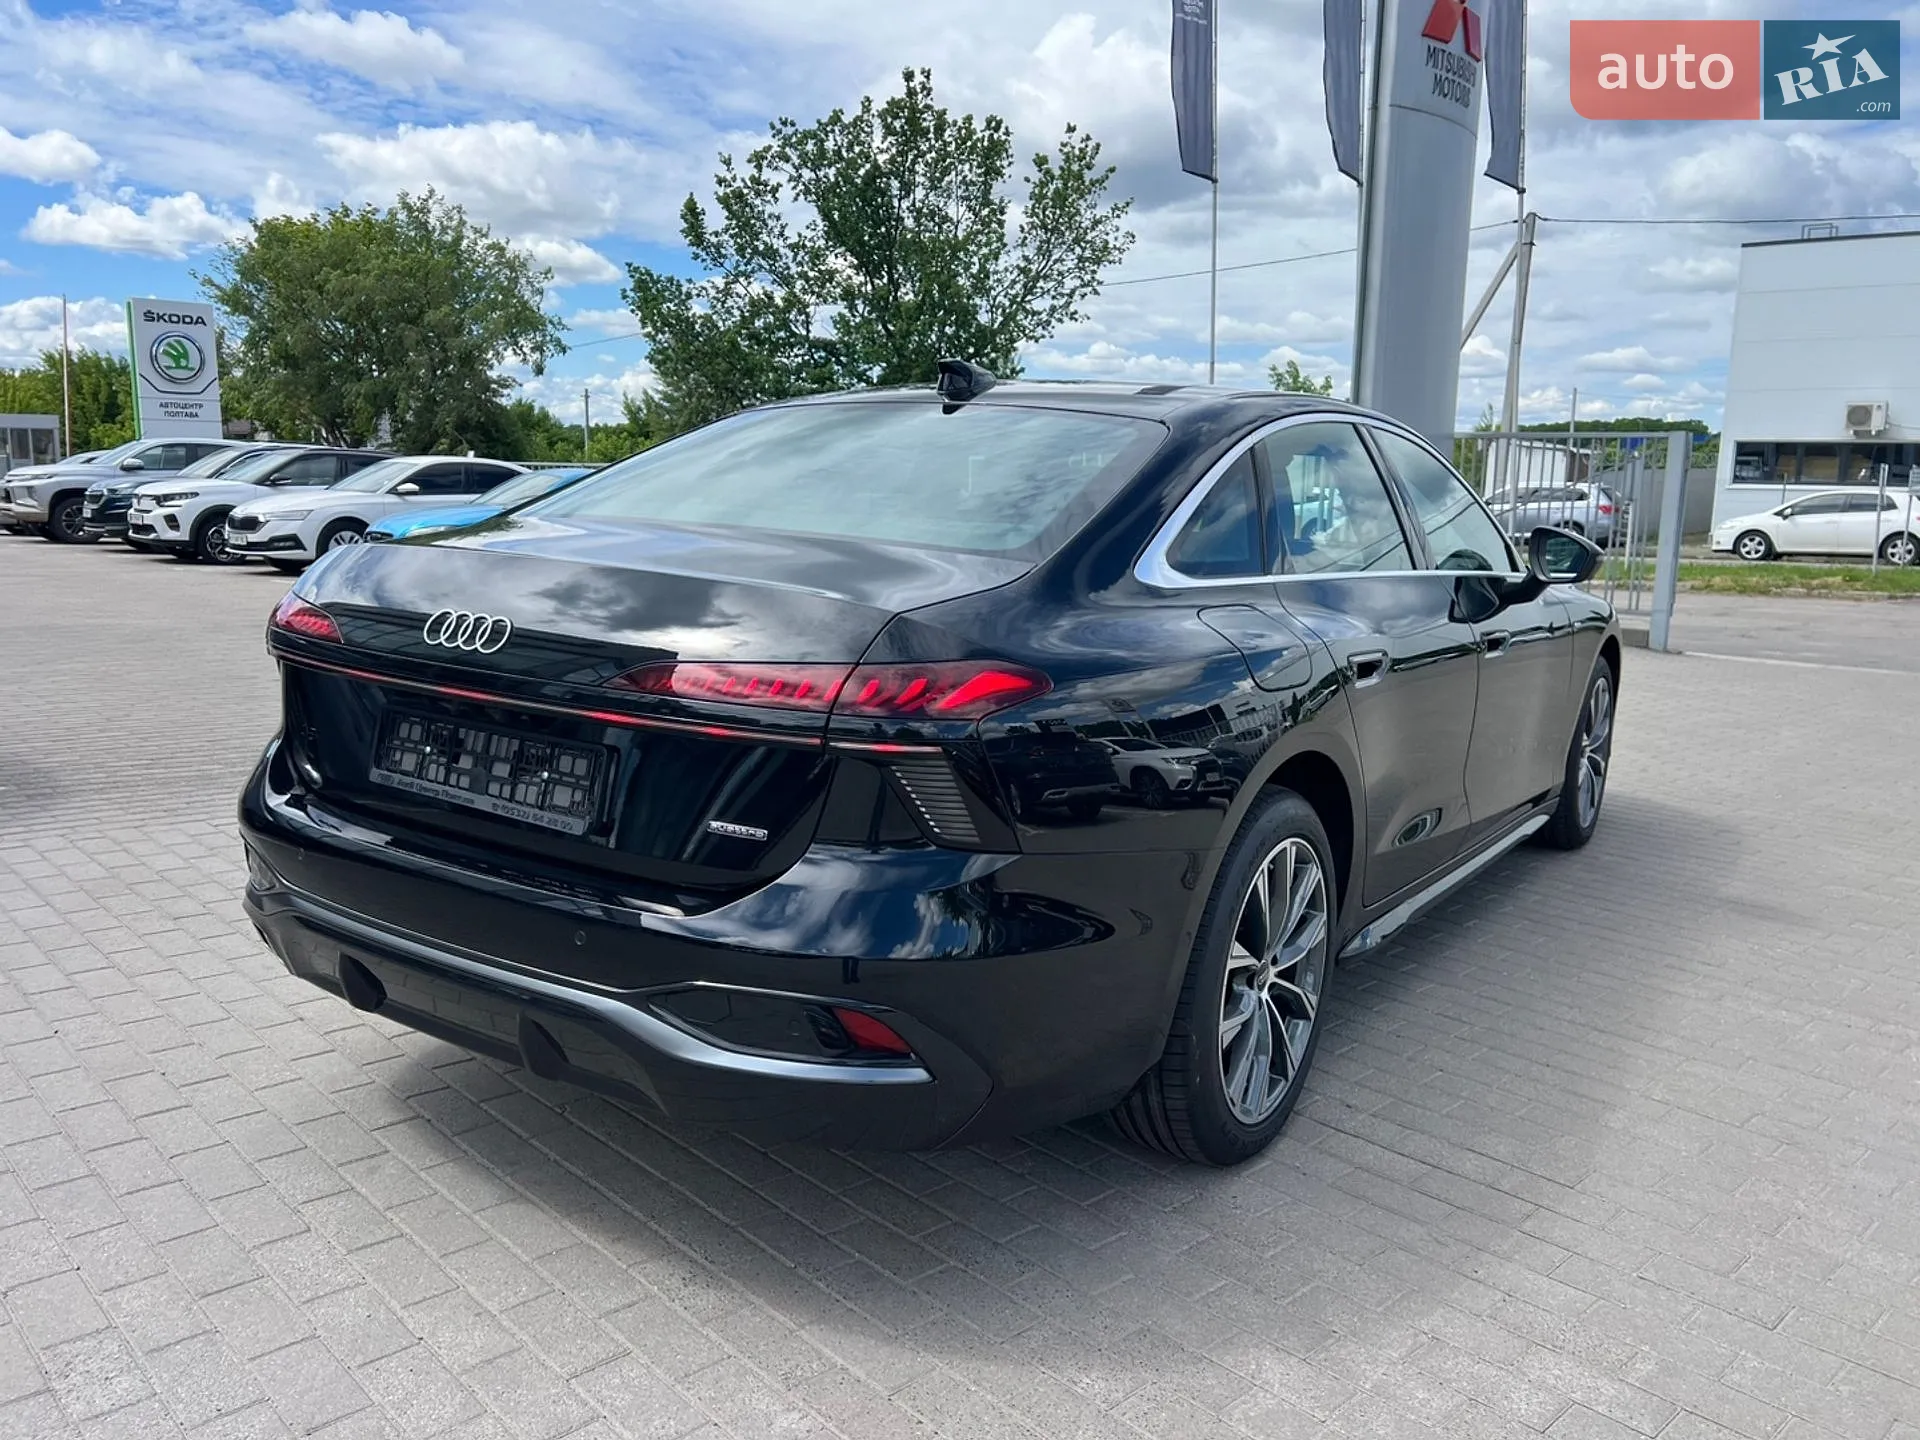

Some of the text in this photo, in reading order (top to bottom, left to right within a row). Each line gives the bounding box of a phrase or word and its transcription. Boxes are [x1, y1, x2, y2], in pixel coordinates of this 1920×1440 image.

[1431, 72, 1471, 108] MOTORS
[143, 309, 207, 326] ŠKODA
[159, 401, 204, 411] АВТОЦЕНТР
[164, 410, 199, 418] ПОЛТАВА
